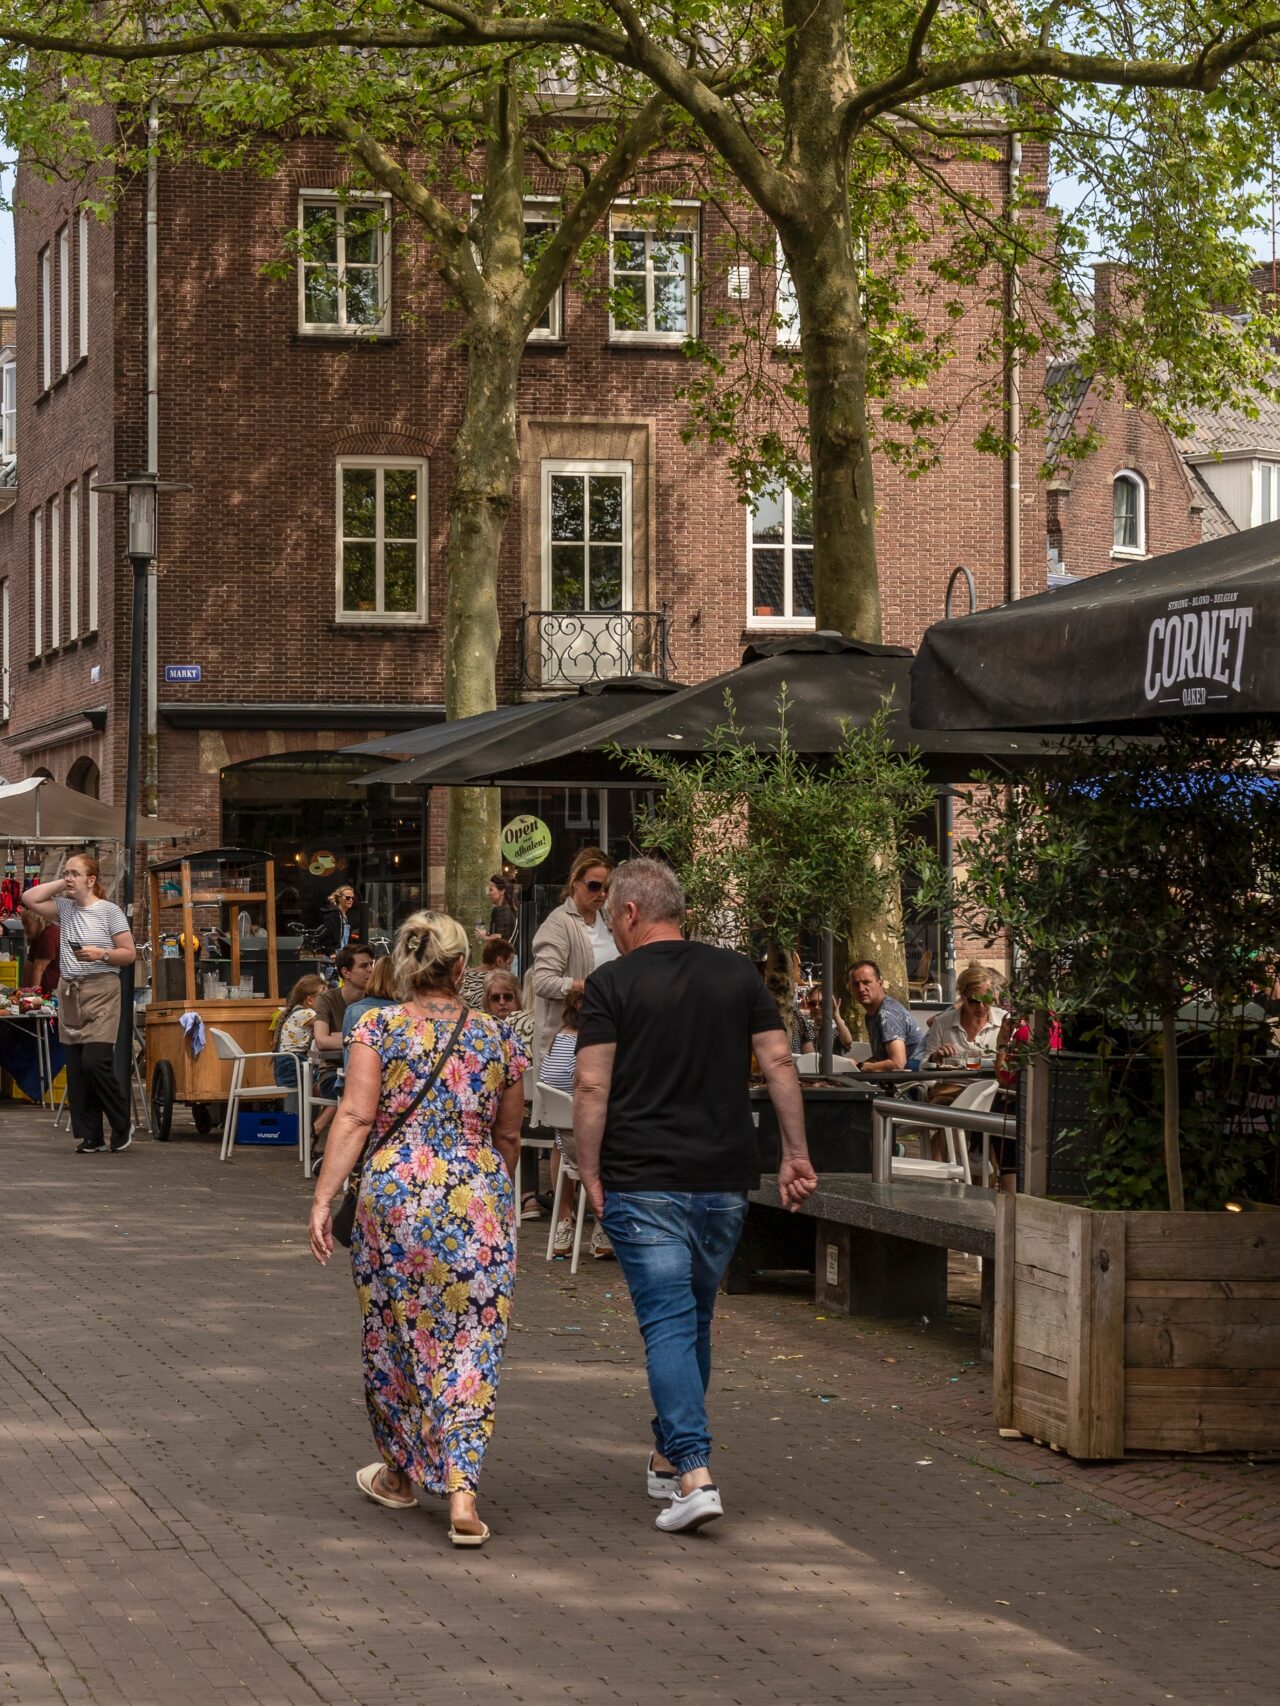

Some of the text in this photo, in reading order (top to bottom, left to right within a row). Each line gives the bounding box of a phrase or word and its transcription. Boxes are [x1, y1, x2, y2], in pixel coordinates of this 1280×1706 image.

[1167, 598, 1189, 610] STRONG
[1192, 595, 1210, 606] BLOND
[1213, 592, 1239, 603] BELGIAN
[1144, 606, 1254, 701] CORNET
[169, 669, 197, 678] MARKT
[1182, 687, 1206, 706] OAKED
[504, 820, 539, 844] Open
[514, 835, 546, 858] afhalen!
